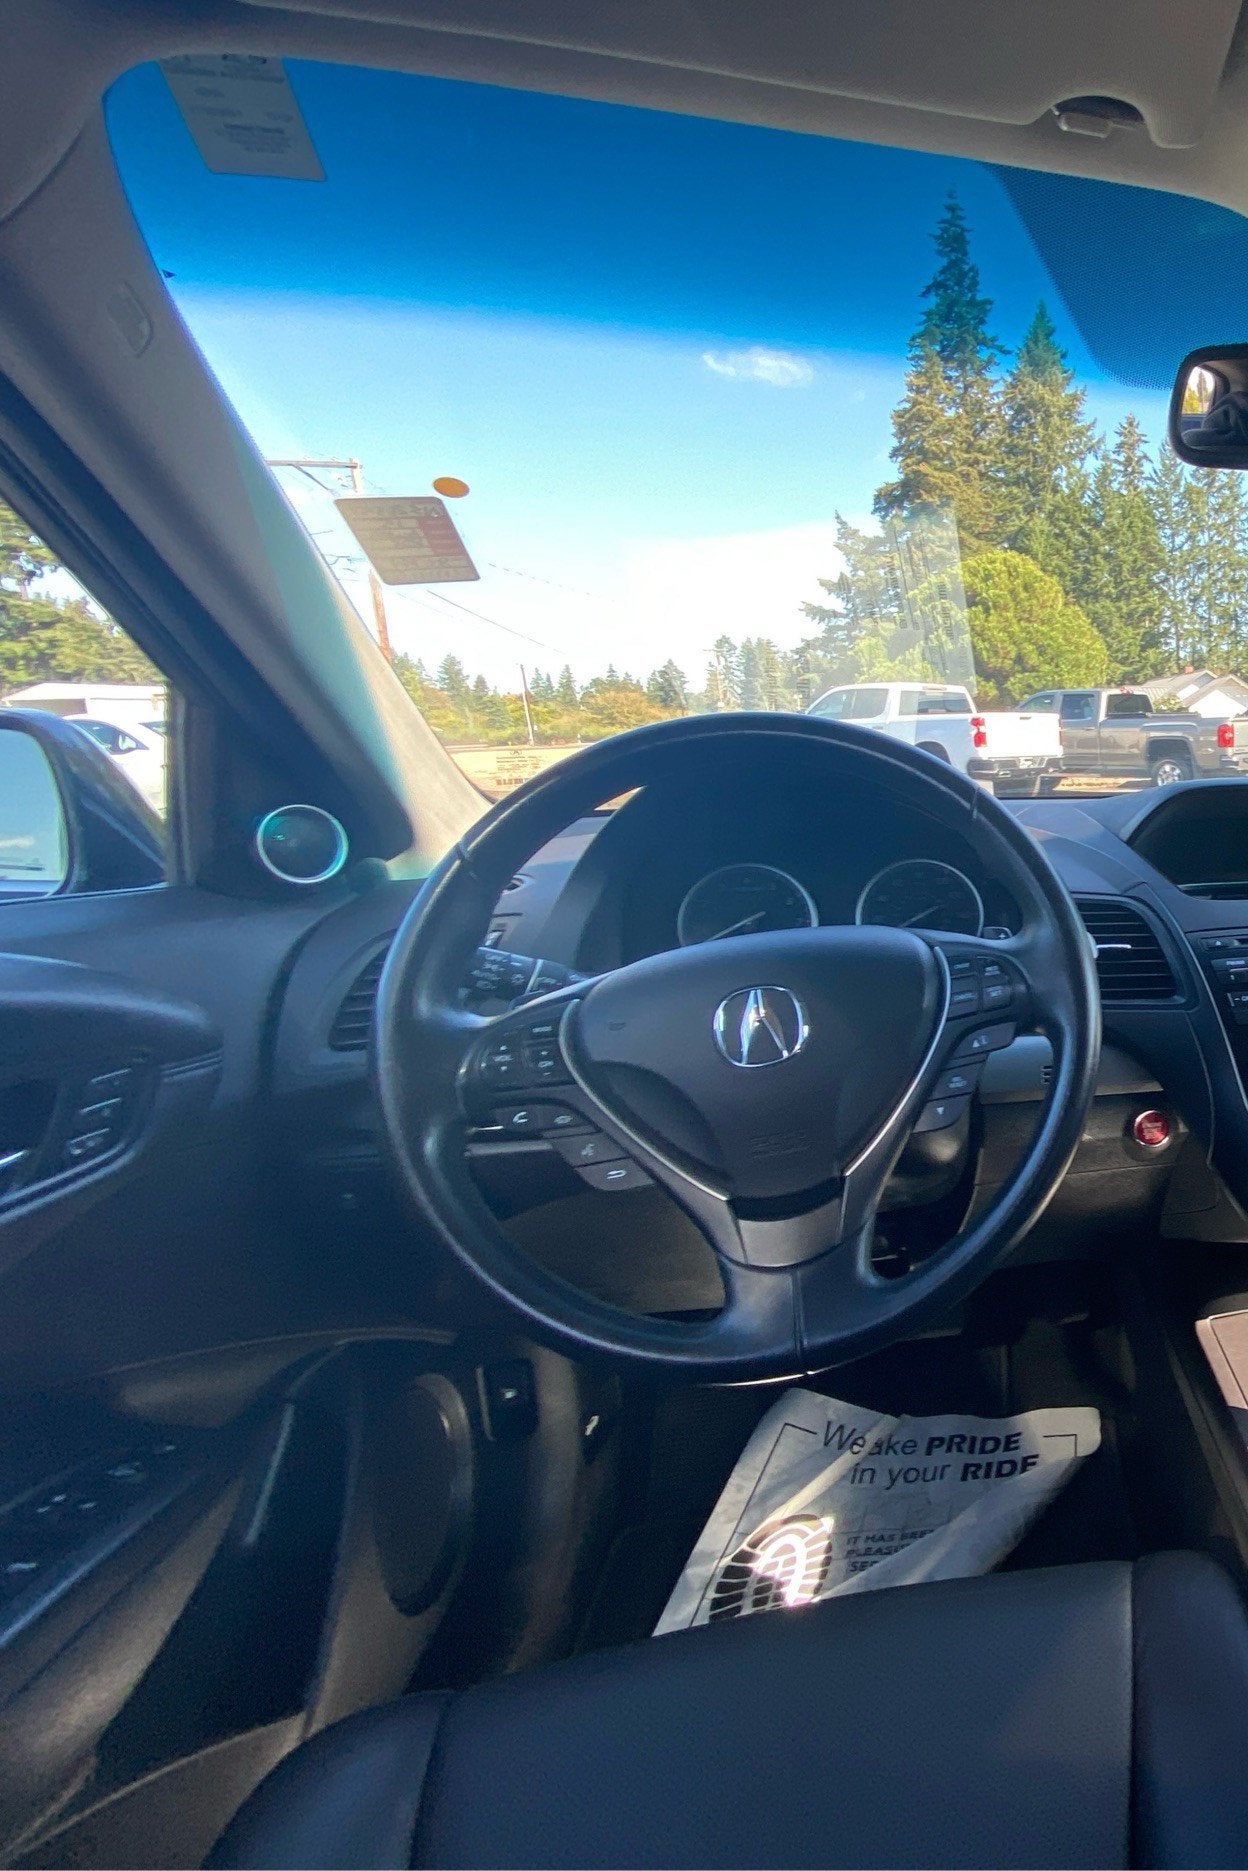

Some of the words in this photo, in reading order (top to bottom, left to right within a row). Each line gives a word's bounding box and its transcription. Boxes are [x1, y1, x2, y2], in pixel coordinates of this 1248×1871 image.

[868, 1432, 918, 1455] ake
[925, 1432, 1023, 1456] PRIDE
[851, 1462, 877, 1485] in
[885, 1463, 952, 1491] your
[960, 1454, 1041, 1482] RIDE
[865, 1533, 896, 1543] HAS
